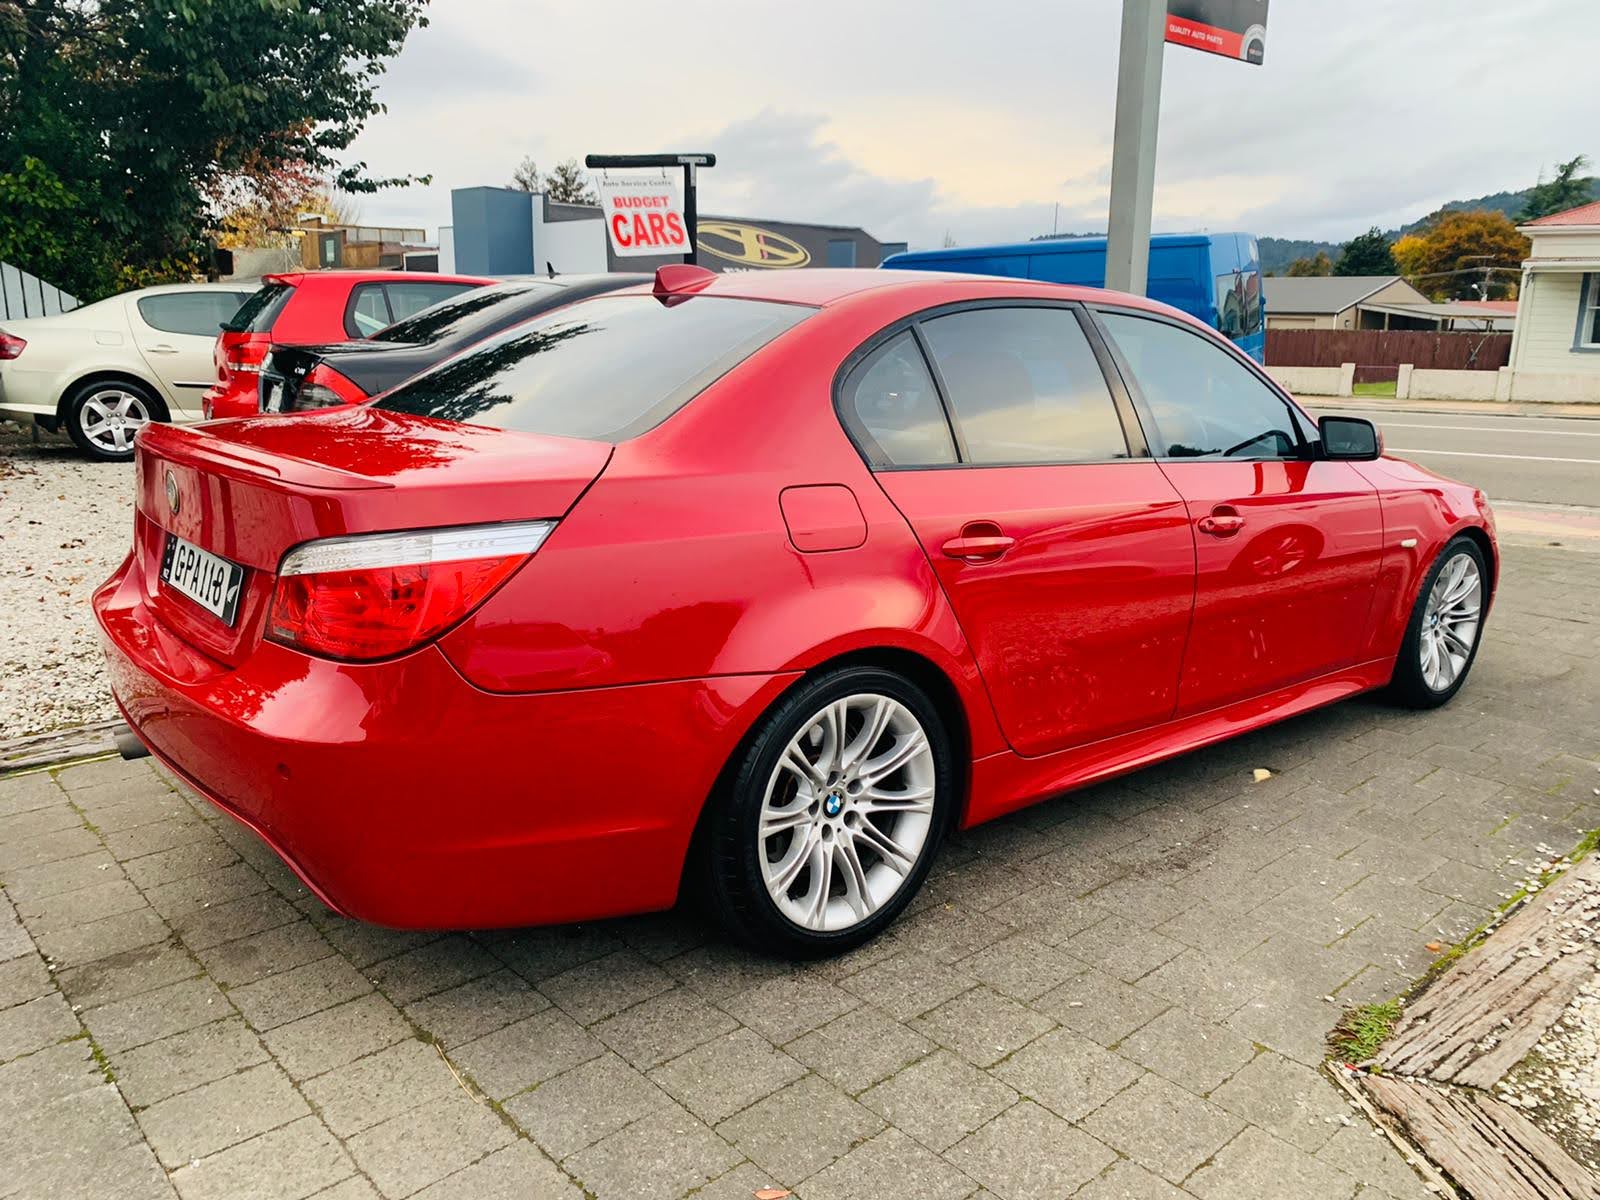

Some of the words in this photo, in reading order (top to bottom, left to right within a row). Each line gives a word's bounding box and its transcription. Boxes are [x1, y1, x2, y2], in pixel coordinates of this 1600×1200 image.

[1169, 24, 1191, 36] QUALITY
[1191, 31, 1205, 40] AUTO
[1206, 33, 1223, 45] PARTS
[613, 196, 669, 208] BUDGET
[612, 212, 685, 247] CARS
[174, 544, 225, 607] GPA118
